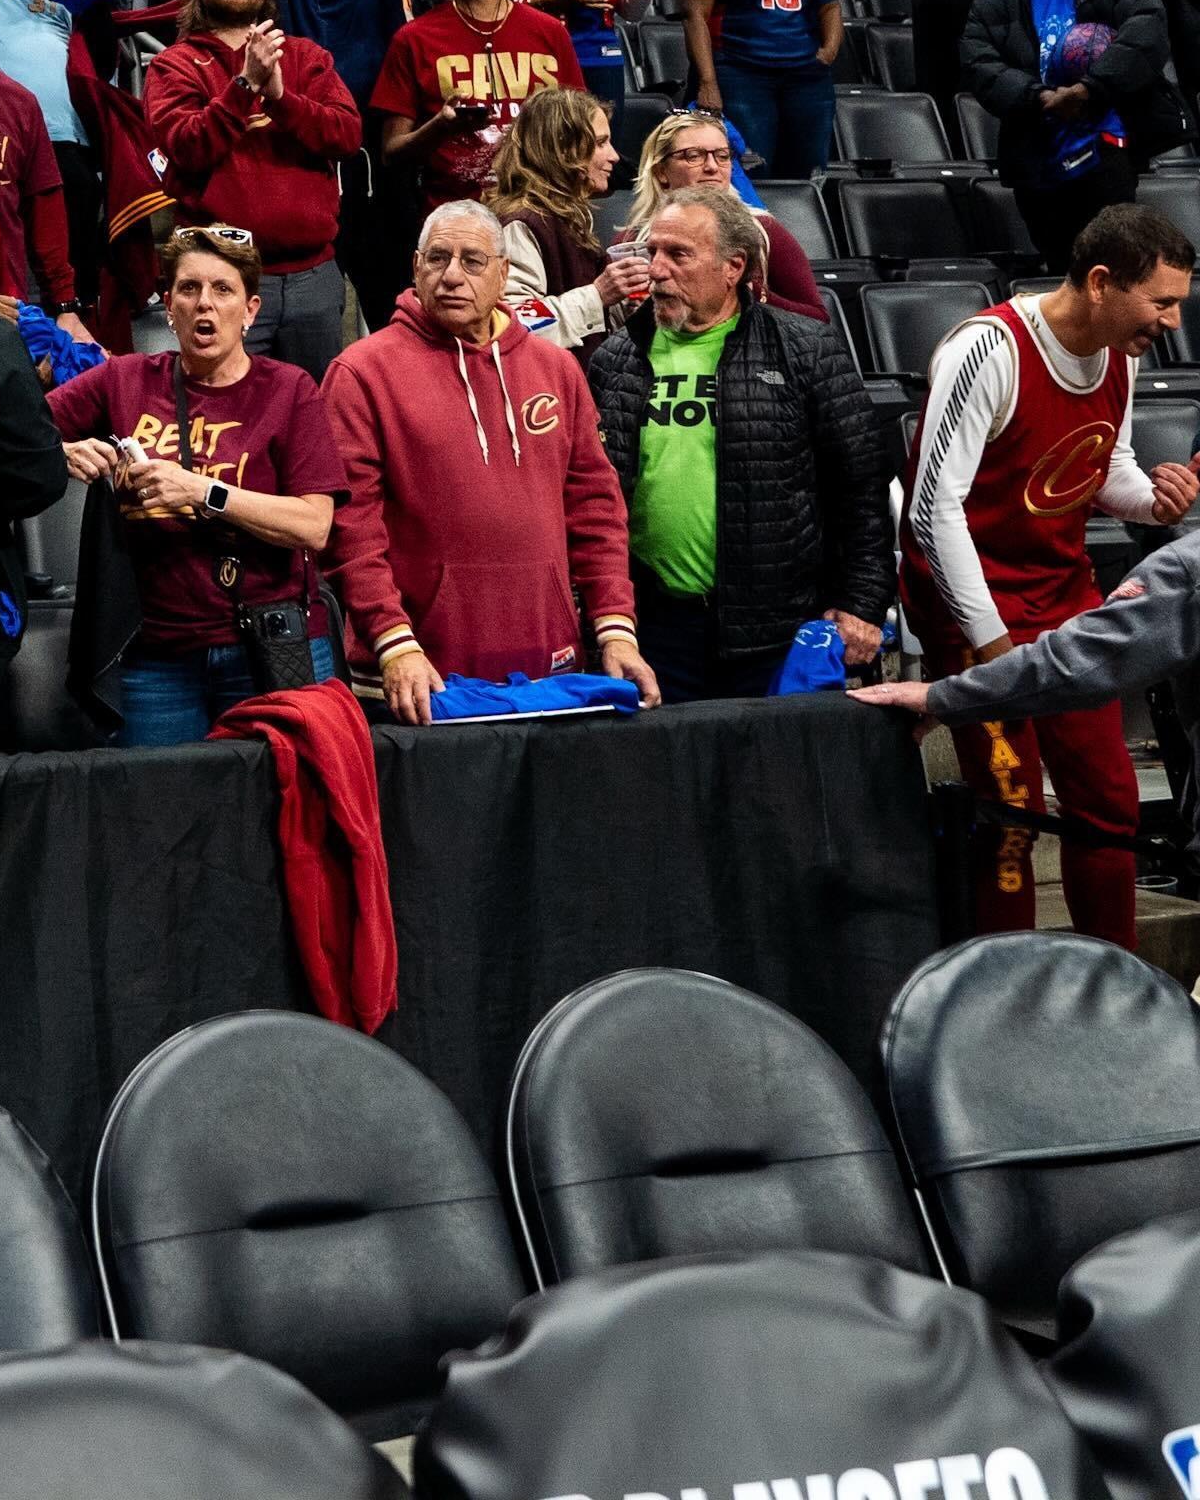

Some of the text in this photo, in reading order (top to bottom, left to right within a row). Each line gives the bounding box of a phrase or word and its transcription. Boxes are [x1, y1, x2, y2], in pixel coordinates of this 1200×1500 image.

[436, 51, 559, 101] CAVS
[695, 374, 717, 399] E
[641, 400, 717, 428] NO
